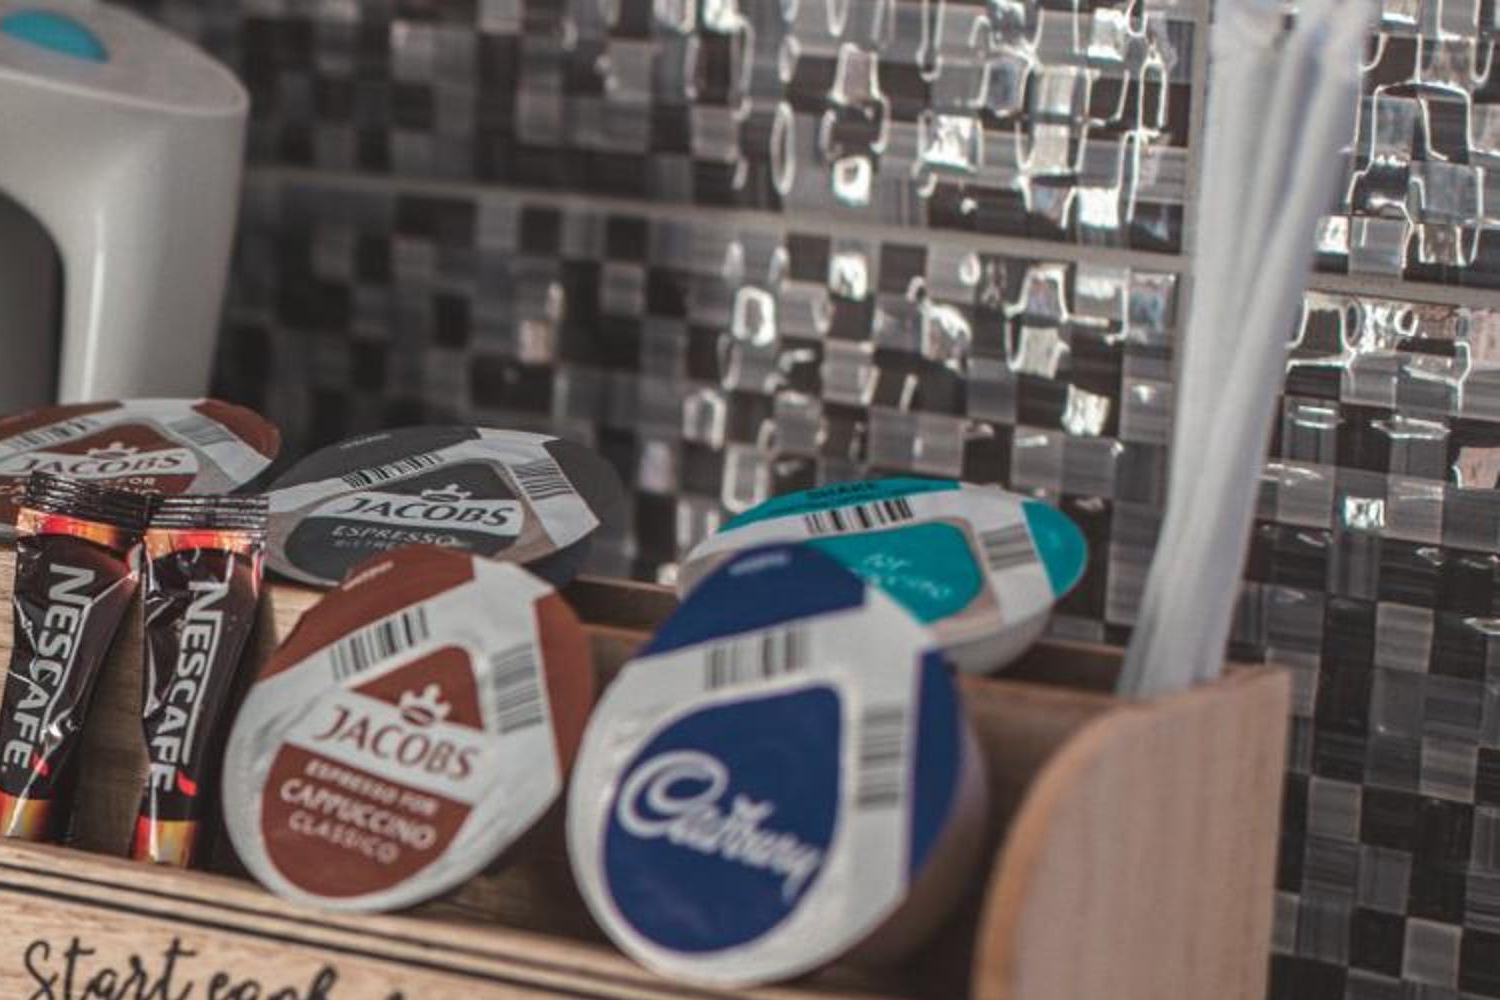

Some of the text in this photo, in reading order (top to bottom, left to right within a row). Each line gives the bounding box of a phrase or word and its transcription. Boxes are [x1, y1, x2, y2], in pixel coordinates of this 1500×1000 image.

[14, 452, 187, 474] JACOBS
[331, 524, 456, 546] ESPRESSO
[334, 497, 516, 527] JACOBS
[312, 703, 483, 782] JACOBS
[279, 777, 438, 851] CAPPUCCINO
[616, 749, 820, 901] Cadbury
